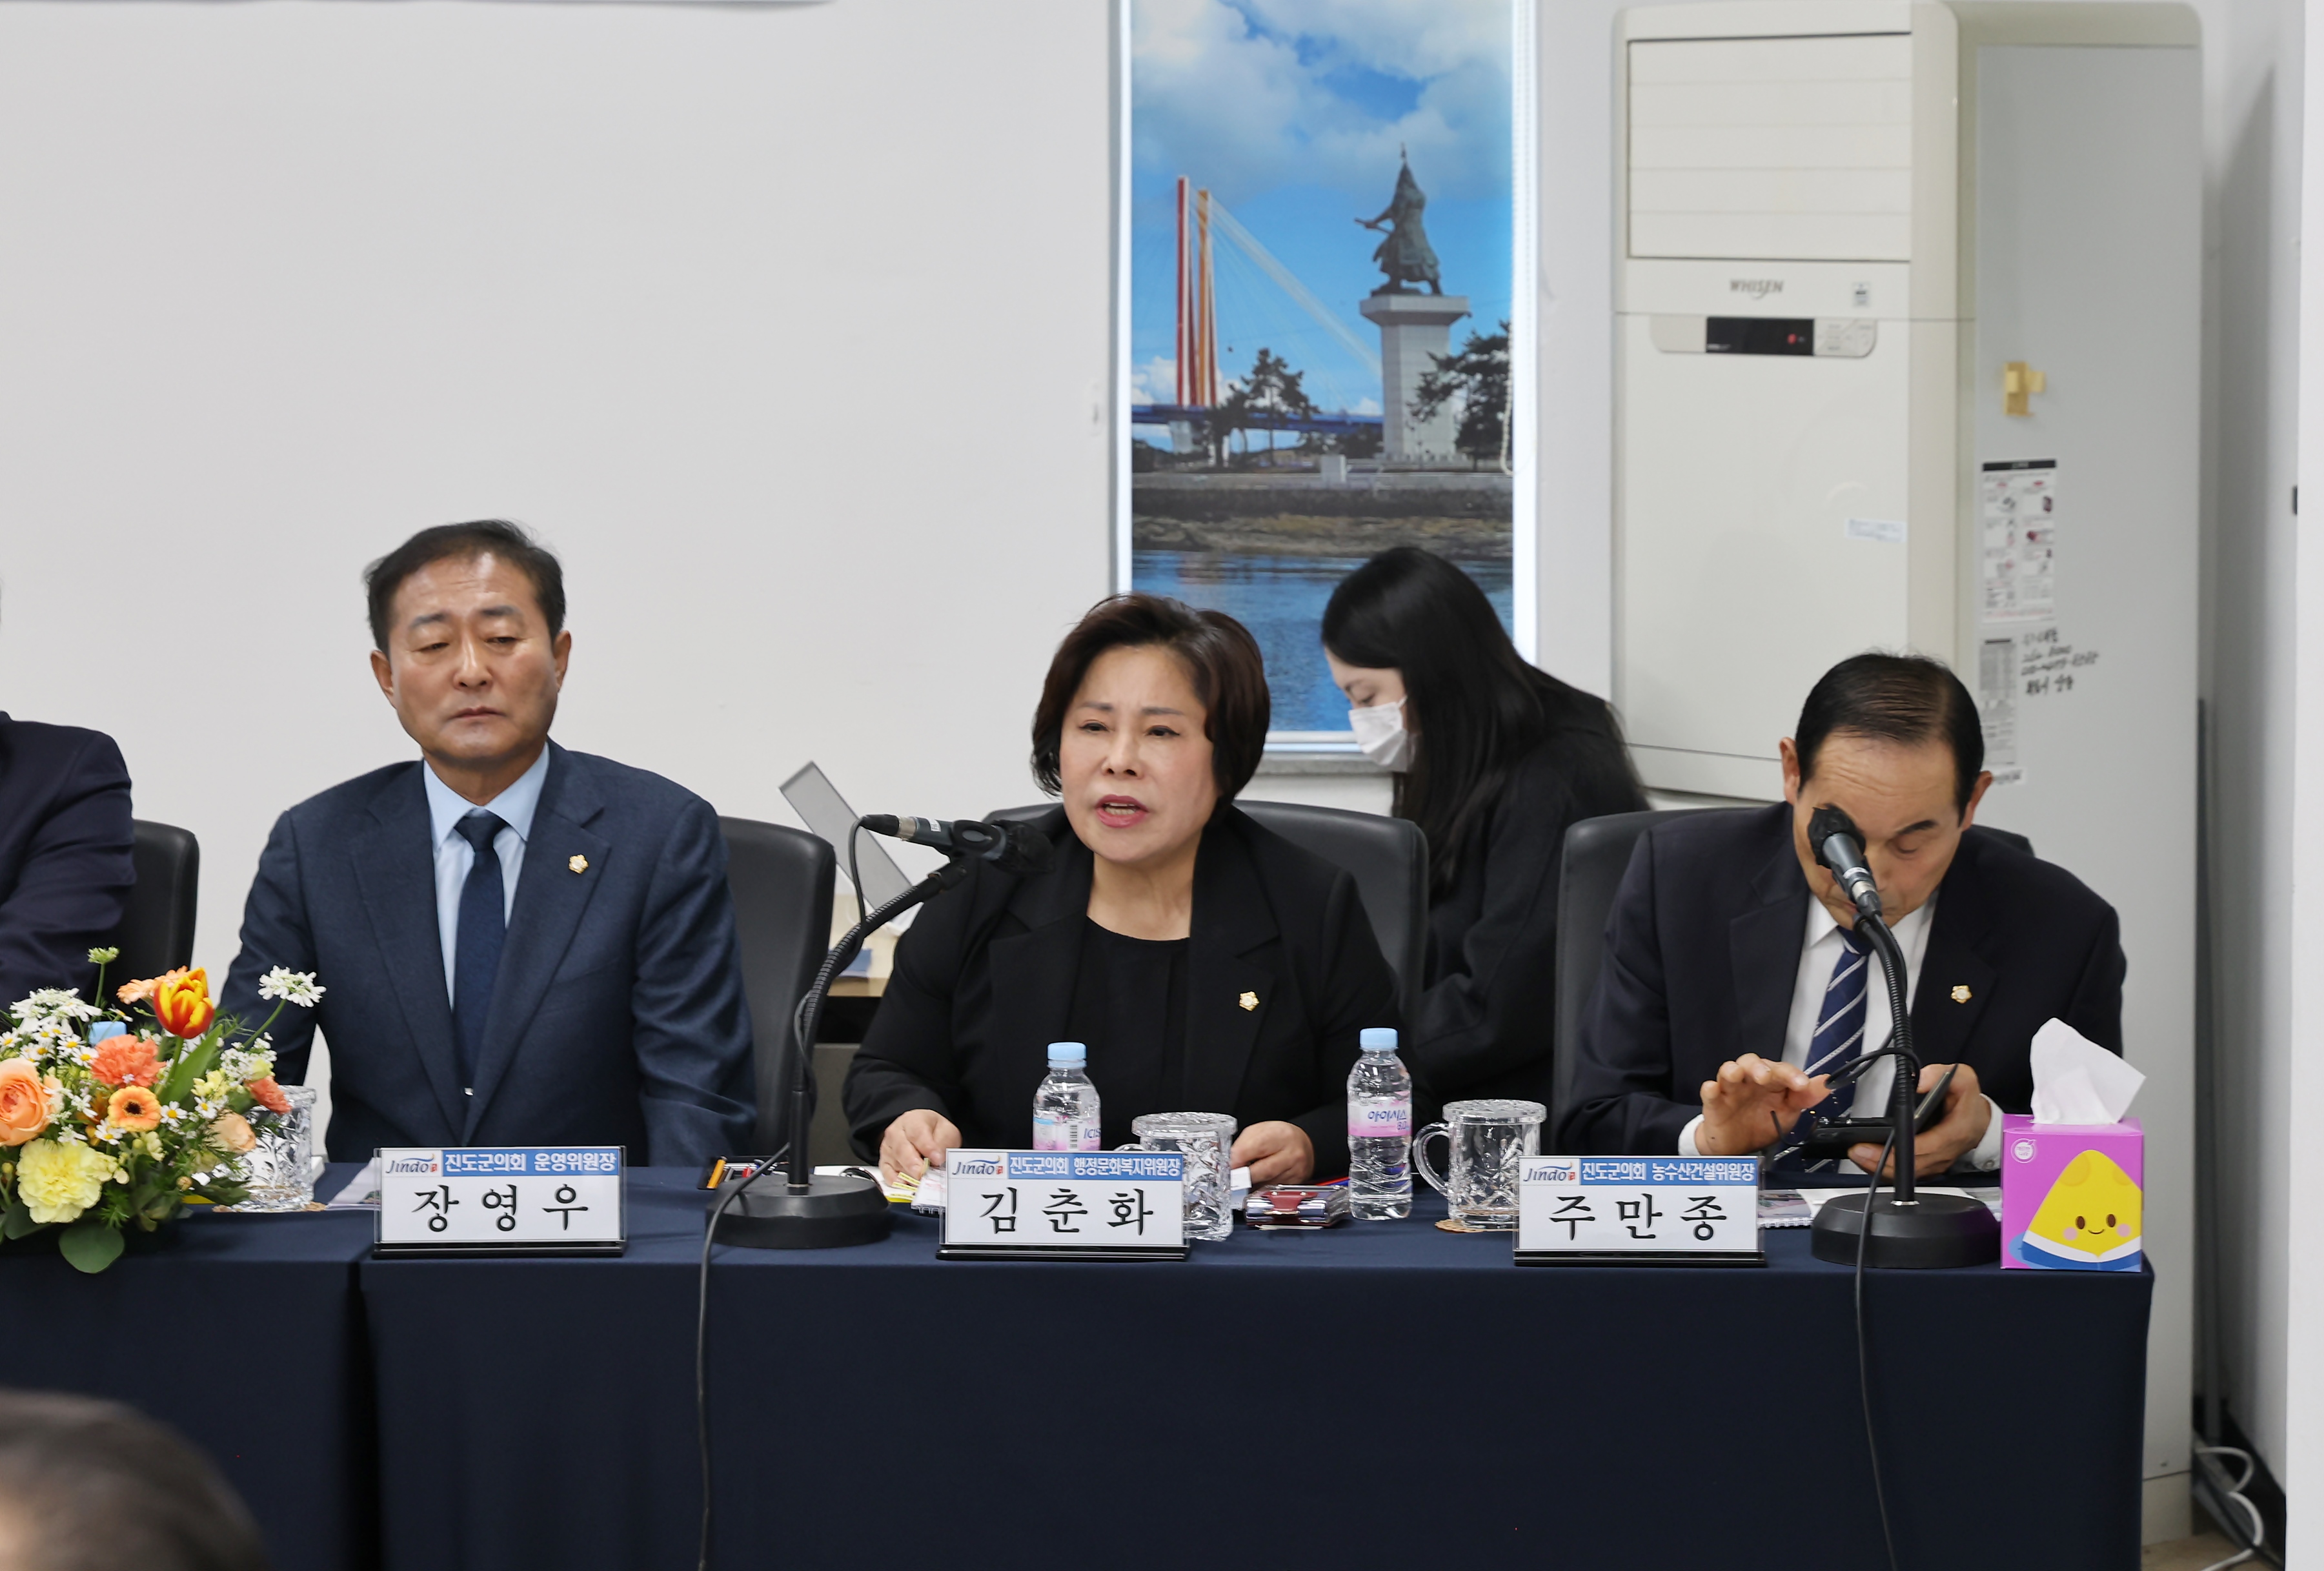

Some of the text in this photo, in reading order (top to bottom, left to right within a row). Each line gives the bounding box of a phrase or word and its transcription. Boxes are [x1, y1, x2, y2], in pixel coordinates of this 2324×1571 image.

[1730, 279, 1784, 294] WHISEN
[1368, 1110, 1407, 1122] 아이시스
[385, 1159, 429, 1174] Jindo
[445, 1152, 617, 1173] 진도군의회 운영위원장
[952, 1161, 995, 1175] Jindo
[1009, 1156, 1182, 1177] 진도군의회 행정문화복지위원장
[1523, 1168, 1567, 1182] Jindo
[1582, 1162, 1755, 1182] 진도군의회 농수산건설위원장
